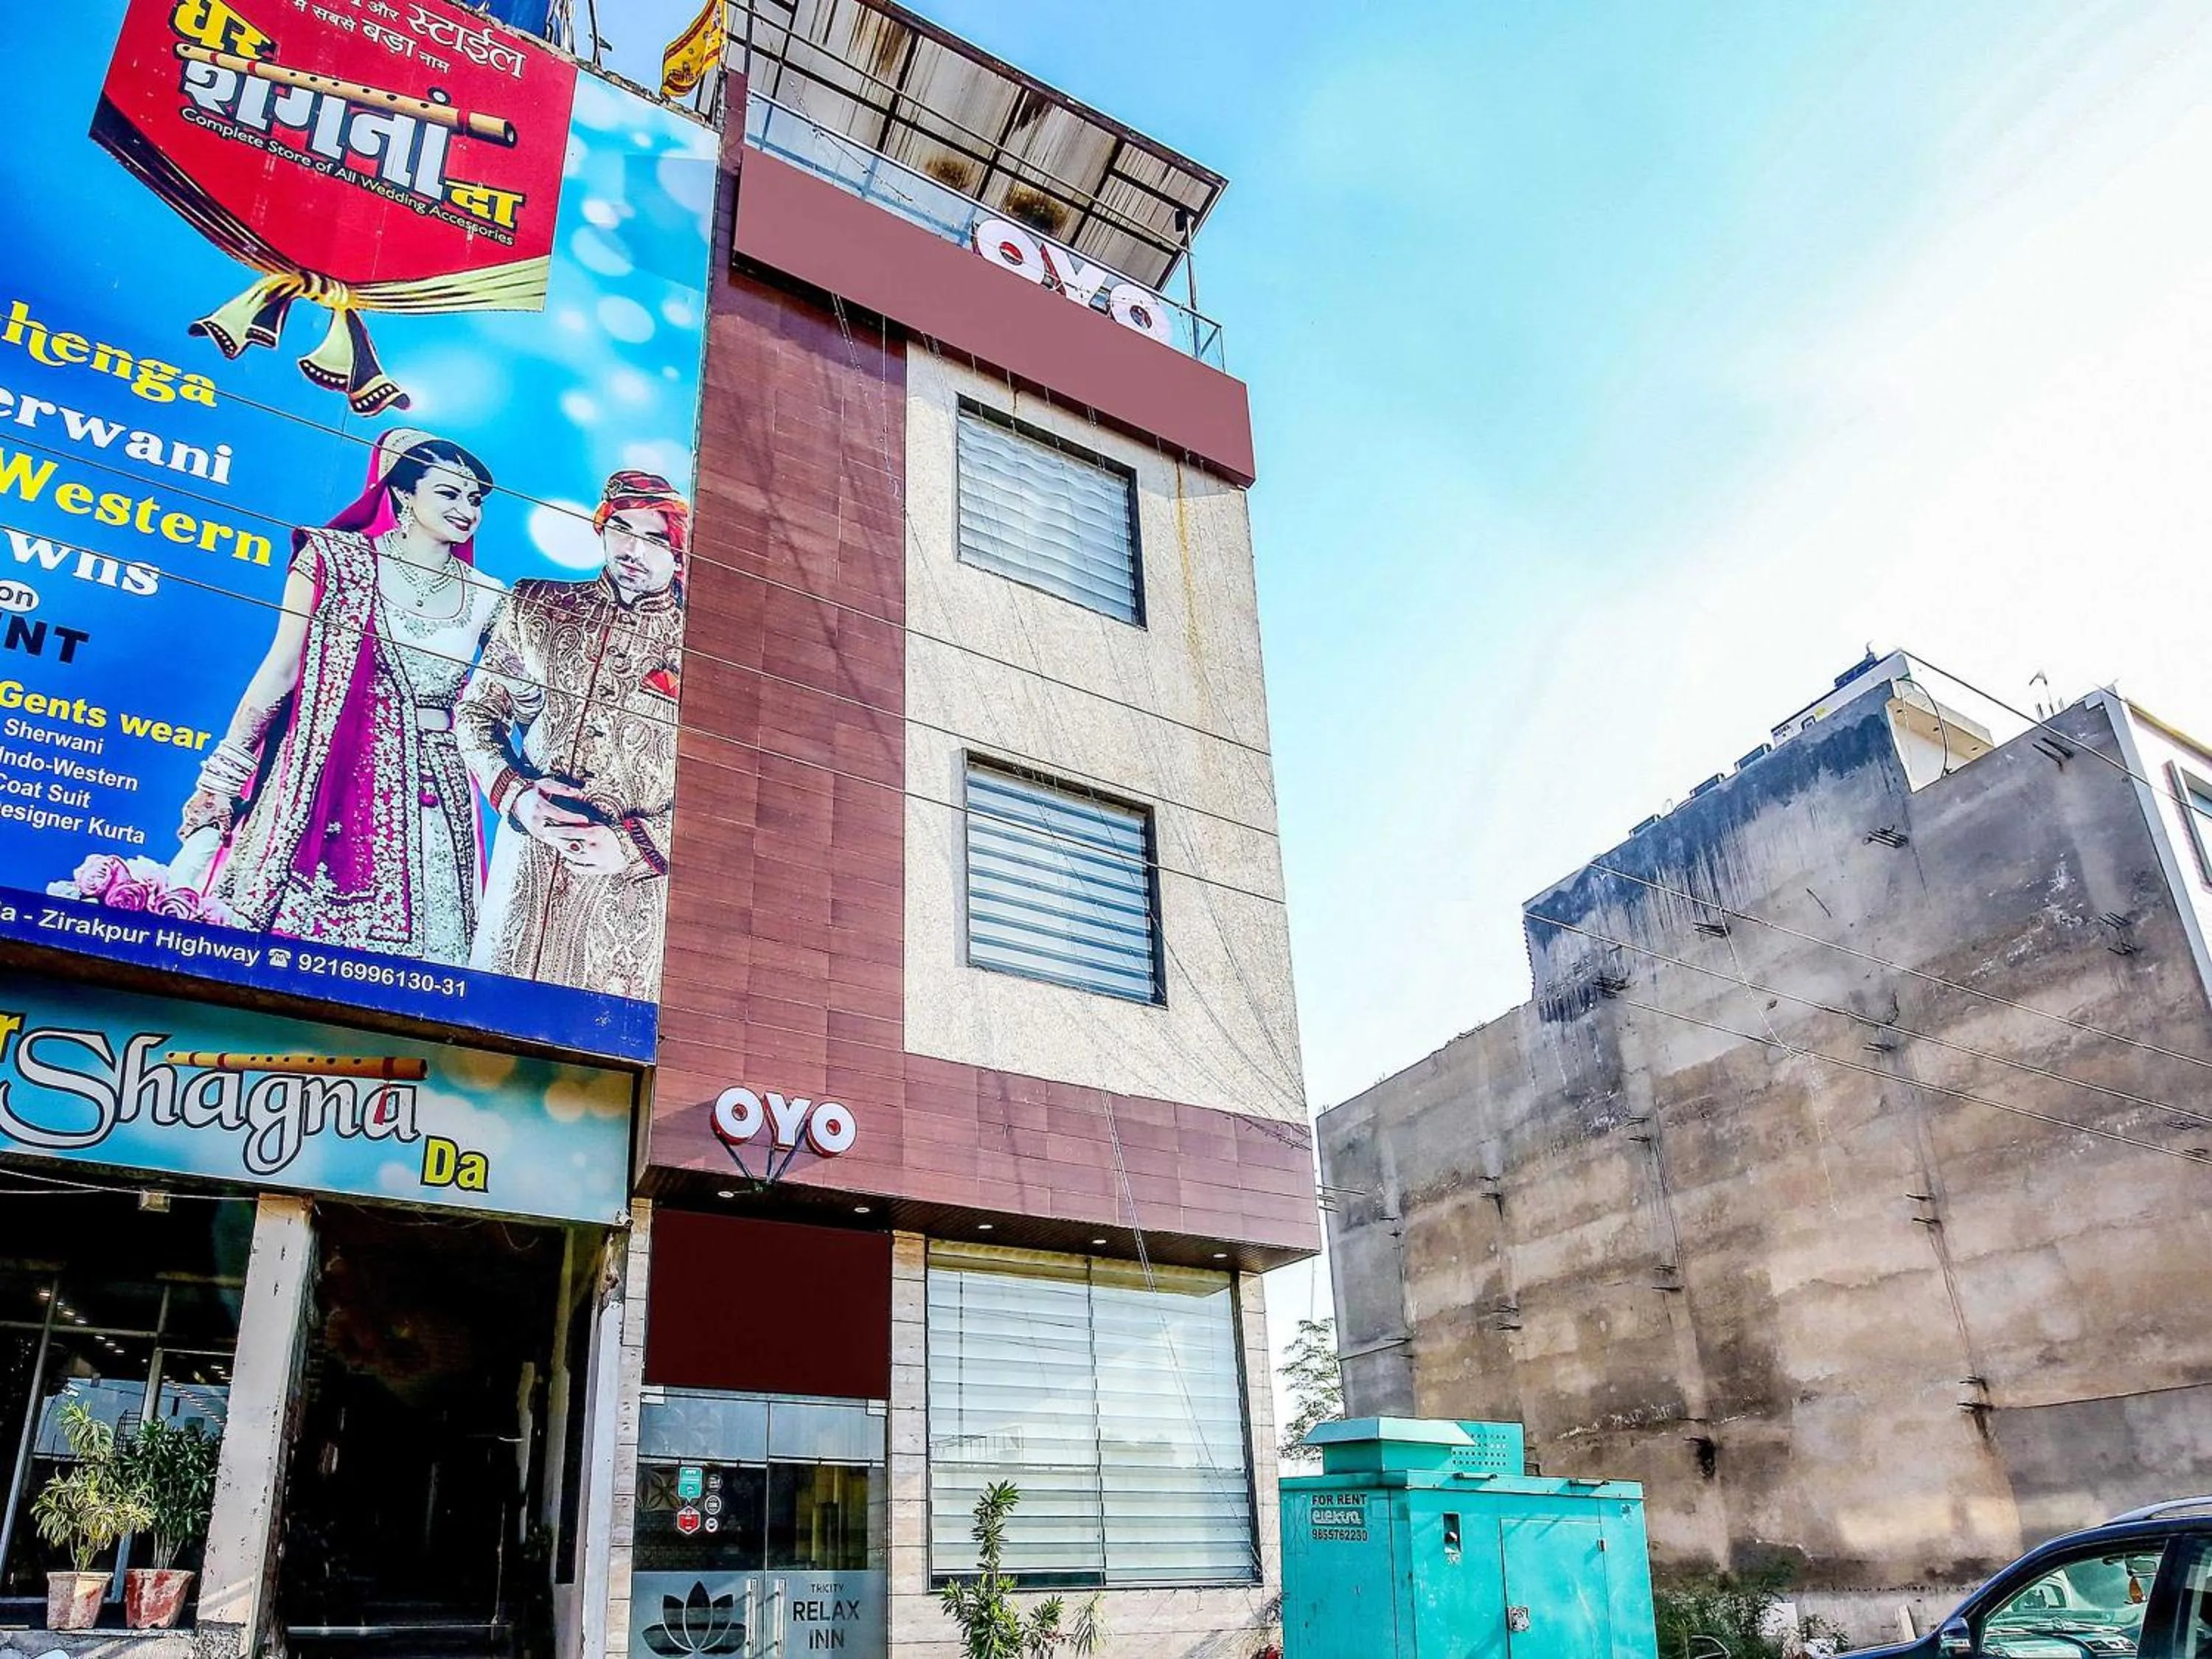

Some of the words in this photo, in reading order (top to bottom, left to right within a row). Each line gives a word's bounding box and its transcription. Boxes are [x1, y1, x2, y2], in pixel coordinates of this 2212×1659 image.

[311, 4, 357, 32] सबसे
[361, 18, 417, 58] बड़ा
[418, 49, 451, 73] नाम
[406, 3, 526, 78] स्टाईल
[181, 107, 265, 148] Complete
[268, 140, 313, 166] Store
[316, 159, 333, 175] of
[336, 168, 357, 184] All
[361, 174, 426, 215] Wedding
[428, 205, 514, 246] Accessories
[973, 219, 1174, 344] OYO
[0, 447, 274, 568] Western
[4, 528, 161, 596] wns
[0, 611, 91, 664] NT
[0, 680, 108, 728] Gents
[119, 712, 212, 752] wear
[4, 717, 105, 756] Sherwani
[0, 745, 139, 791] Indo-Western
[47, 783, 92, 810] Suit
[0, 801, 83, 832] esigner
[88, 816, 146, 845] Kurta
[38, 908, 150, 945] Zirakpur
[156, 928, 260, 967] Highway
[297, 953, 467, 998] 9216996130-31
[0, 1027, 421, 1175] Shagna
[421, 1136, 490, 1194] Da
[711, 1085, 857, 1158] OYO
[1312, 1494, 1334, 1506] FOR
[1337, 1493, 1368, 1505] RENT
[793, 1600, 860, 1621] RELAX
[810, 1582, 844, 1593] TRICITY
[808, 1628, 845, 1649] INN
